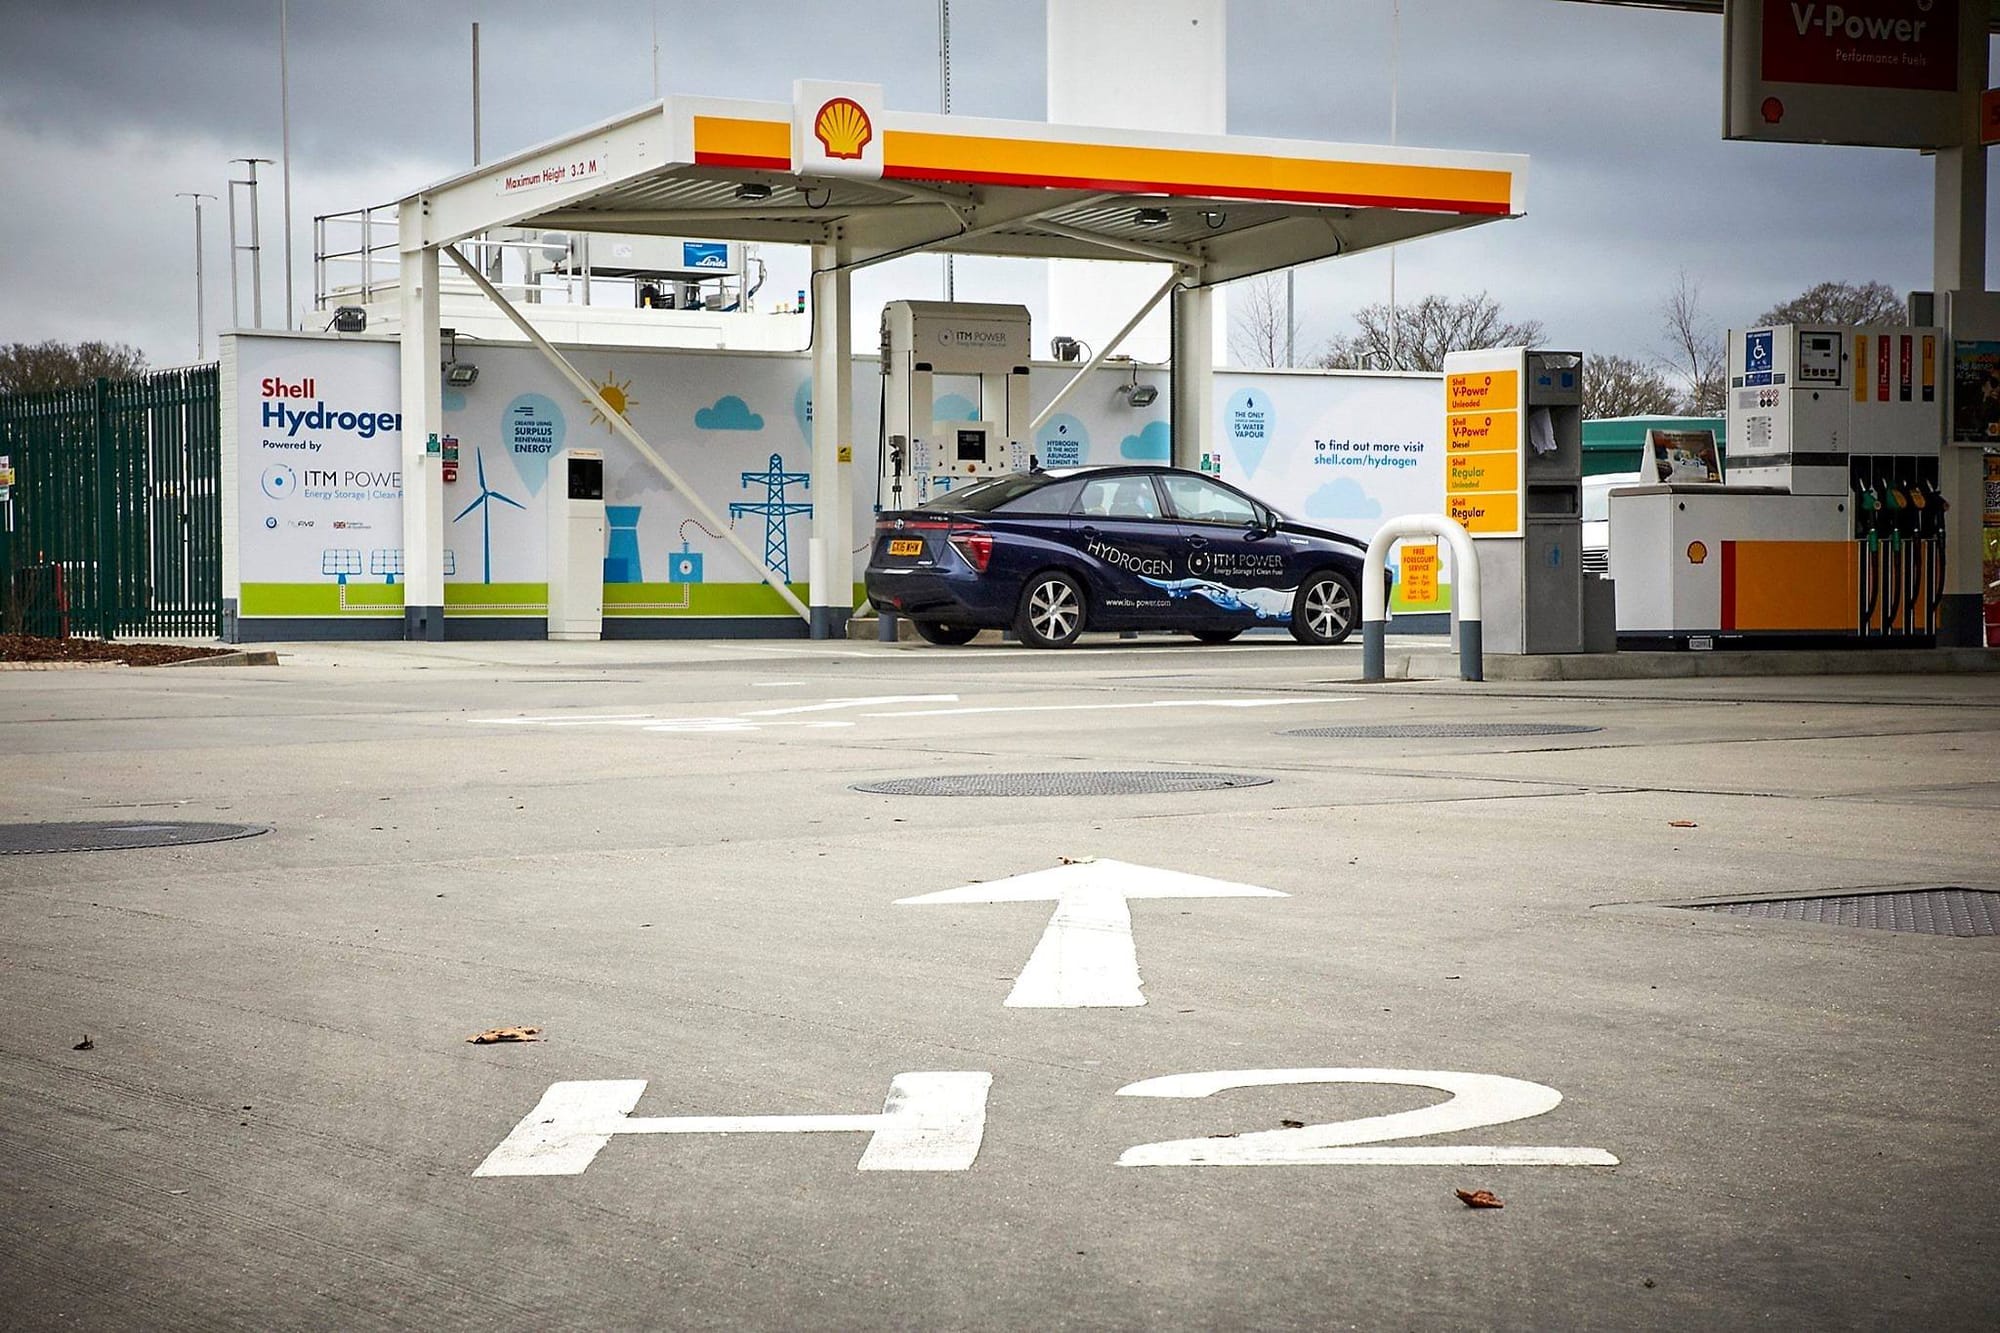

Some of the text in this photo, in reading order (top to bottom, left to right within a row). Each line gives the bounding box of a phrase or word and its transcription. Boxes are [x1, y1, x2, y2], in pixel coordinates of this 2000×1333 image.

[1791, 2, 1927, 42] V-Power
[1835, 48, 1928, 67] Performance Fuels
[505, 159, 597, 190] Maximum Height 3.2 M
[696, 255, 726, 267] Linde
[956, 331, 973, 340] ITM
[1452, 378, 1466, 386] Shell
[262, 377, 315, 399] Shell
[1453, 386, 1488, 397] V-Power
[1452, 400, 1480, 408] Unleaded
[1452, 418, 1466, 426] Shell
[515, 427, 553, 436] SURPLUS
[1235, 430, 1264, 438] VAPOUR
[1453, 427, 1488, 437] V-Power
[263, 440, 322, 452] Powered by
[515, 444, 552, 453] ENERGY
[1314, 439, 1424, 452] To find out more visit
[1452, 440, 1470, 448] Diesel
[1314, 454, 1417, 469] shell.com/hydrogen
[1452, 458, 1466, 466] Shell
[1452, 467, 1485, 479] Regular
[304, 470, 401, 489] ITM POWE
[304, 489, 332, 500] Energy
[335, 490, 366, 500] Storage
[373, 490, 396, 499] Clean
[1452, 498, 1466, 506] Shell
[1452, 507, 1485, 520] Regular
[1088, 542, 1173, 574] HYDROGEN
[1213, 554, 1283, 567] ITM POWER
